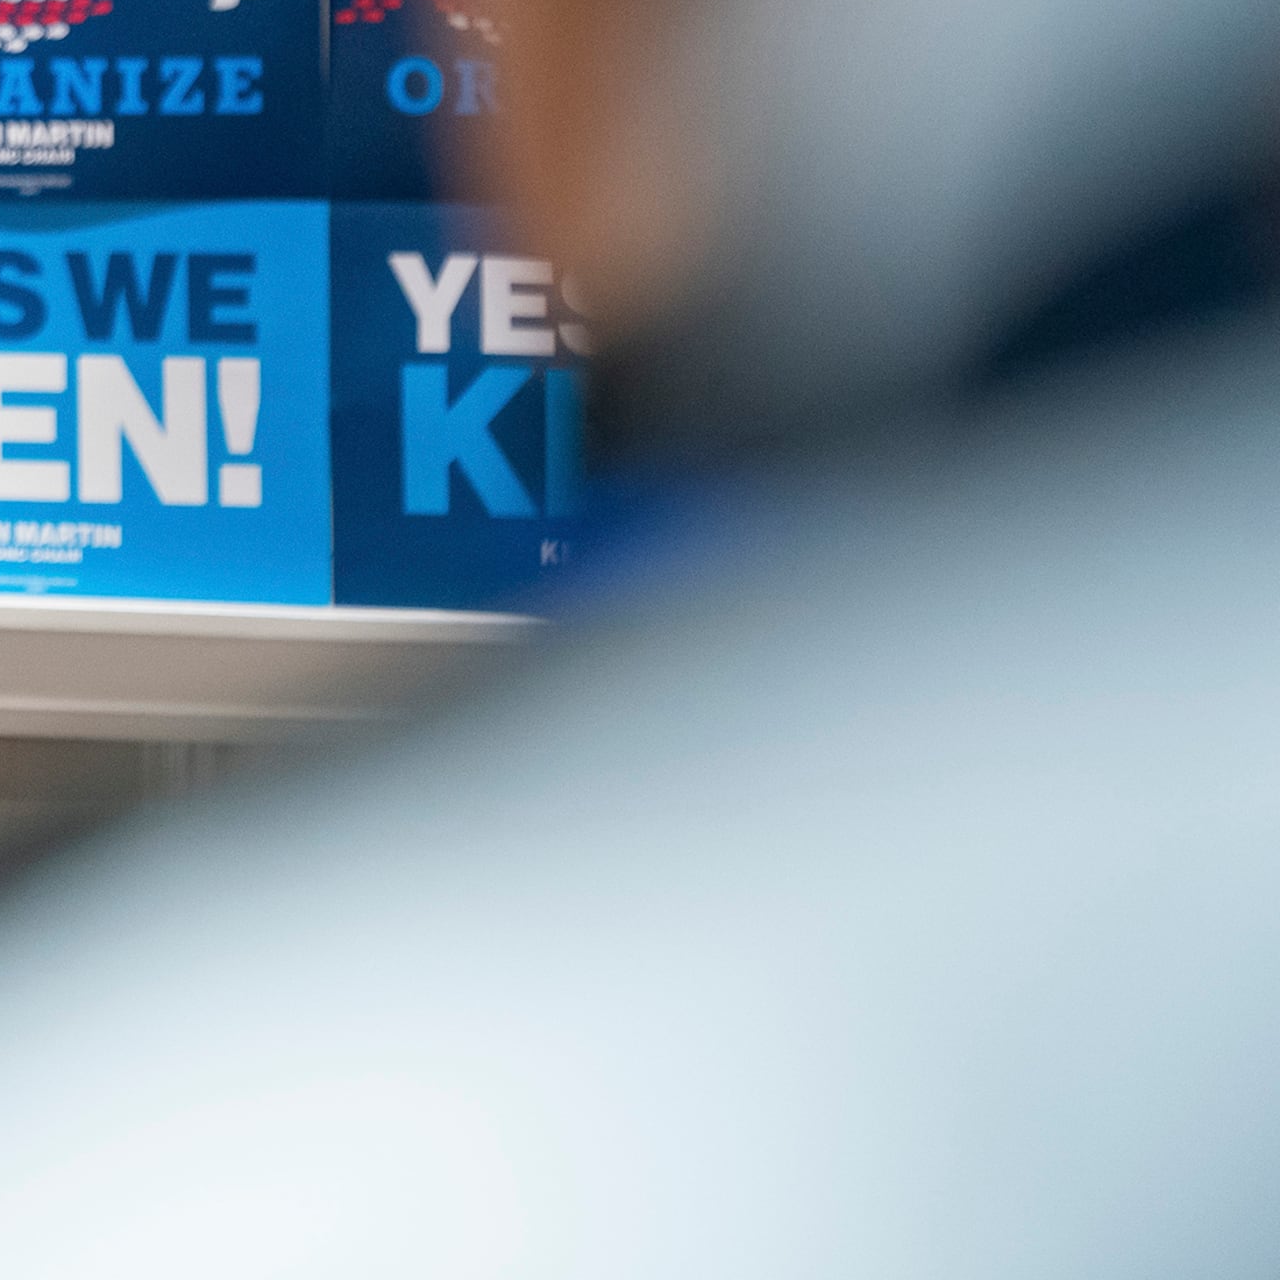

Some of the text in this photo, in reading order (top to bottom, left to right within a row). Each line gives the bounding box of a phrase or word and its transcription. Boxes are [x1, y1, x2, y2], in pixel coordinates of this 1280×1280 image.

[5, 119, 114, 150] MARTIN
[65, 251, 256, 345] WE
[13, 521, 122, 548] MARTIN
